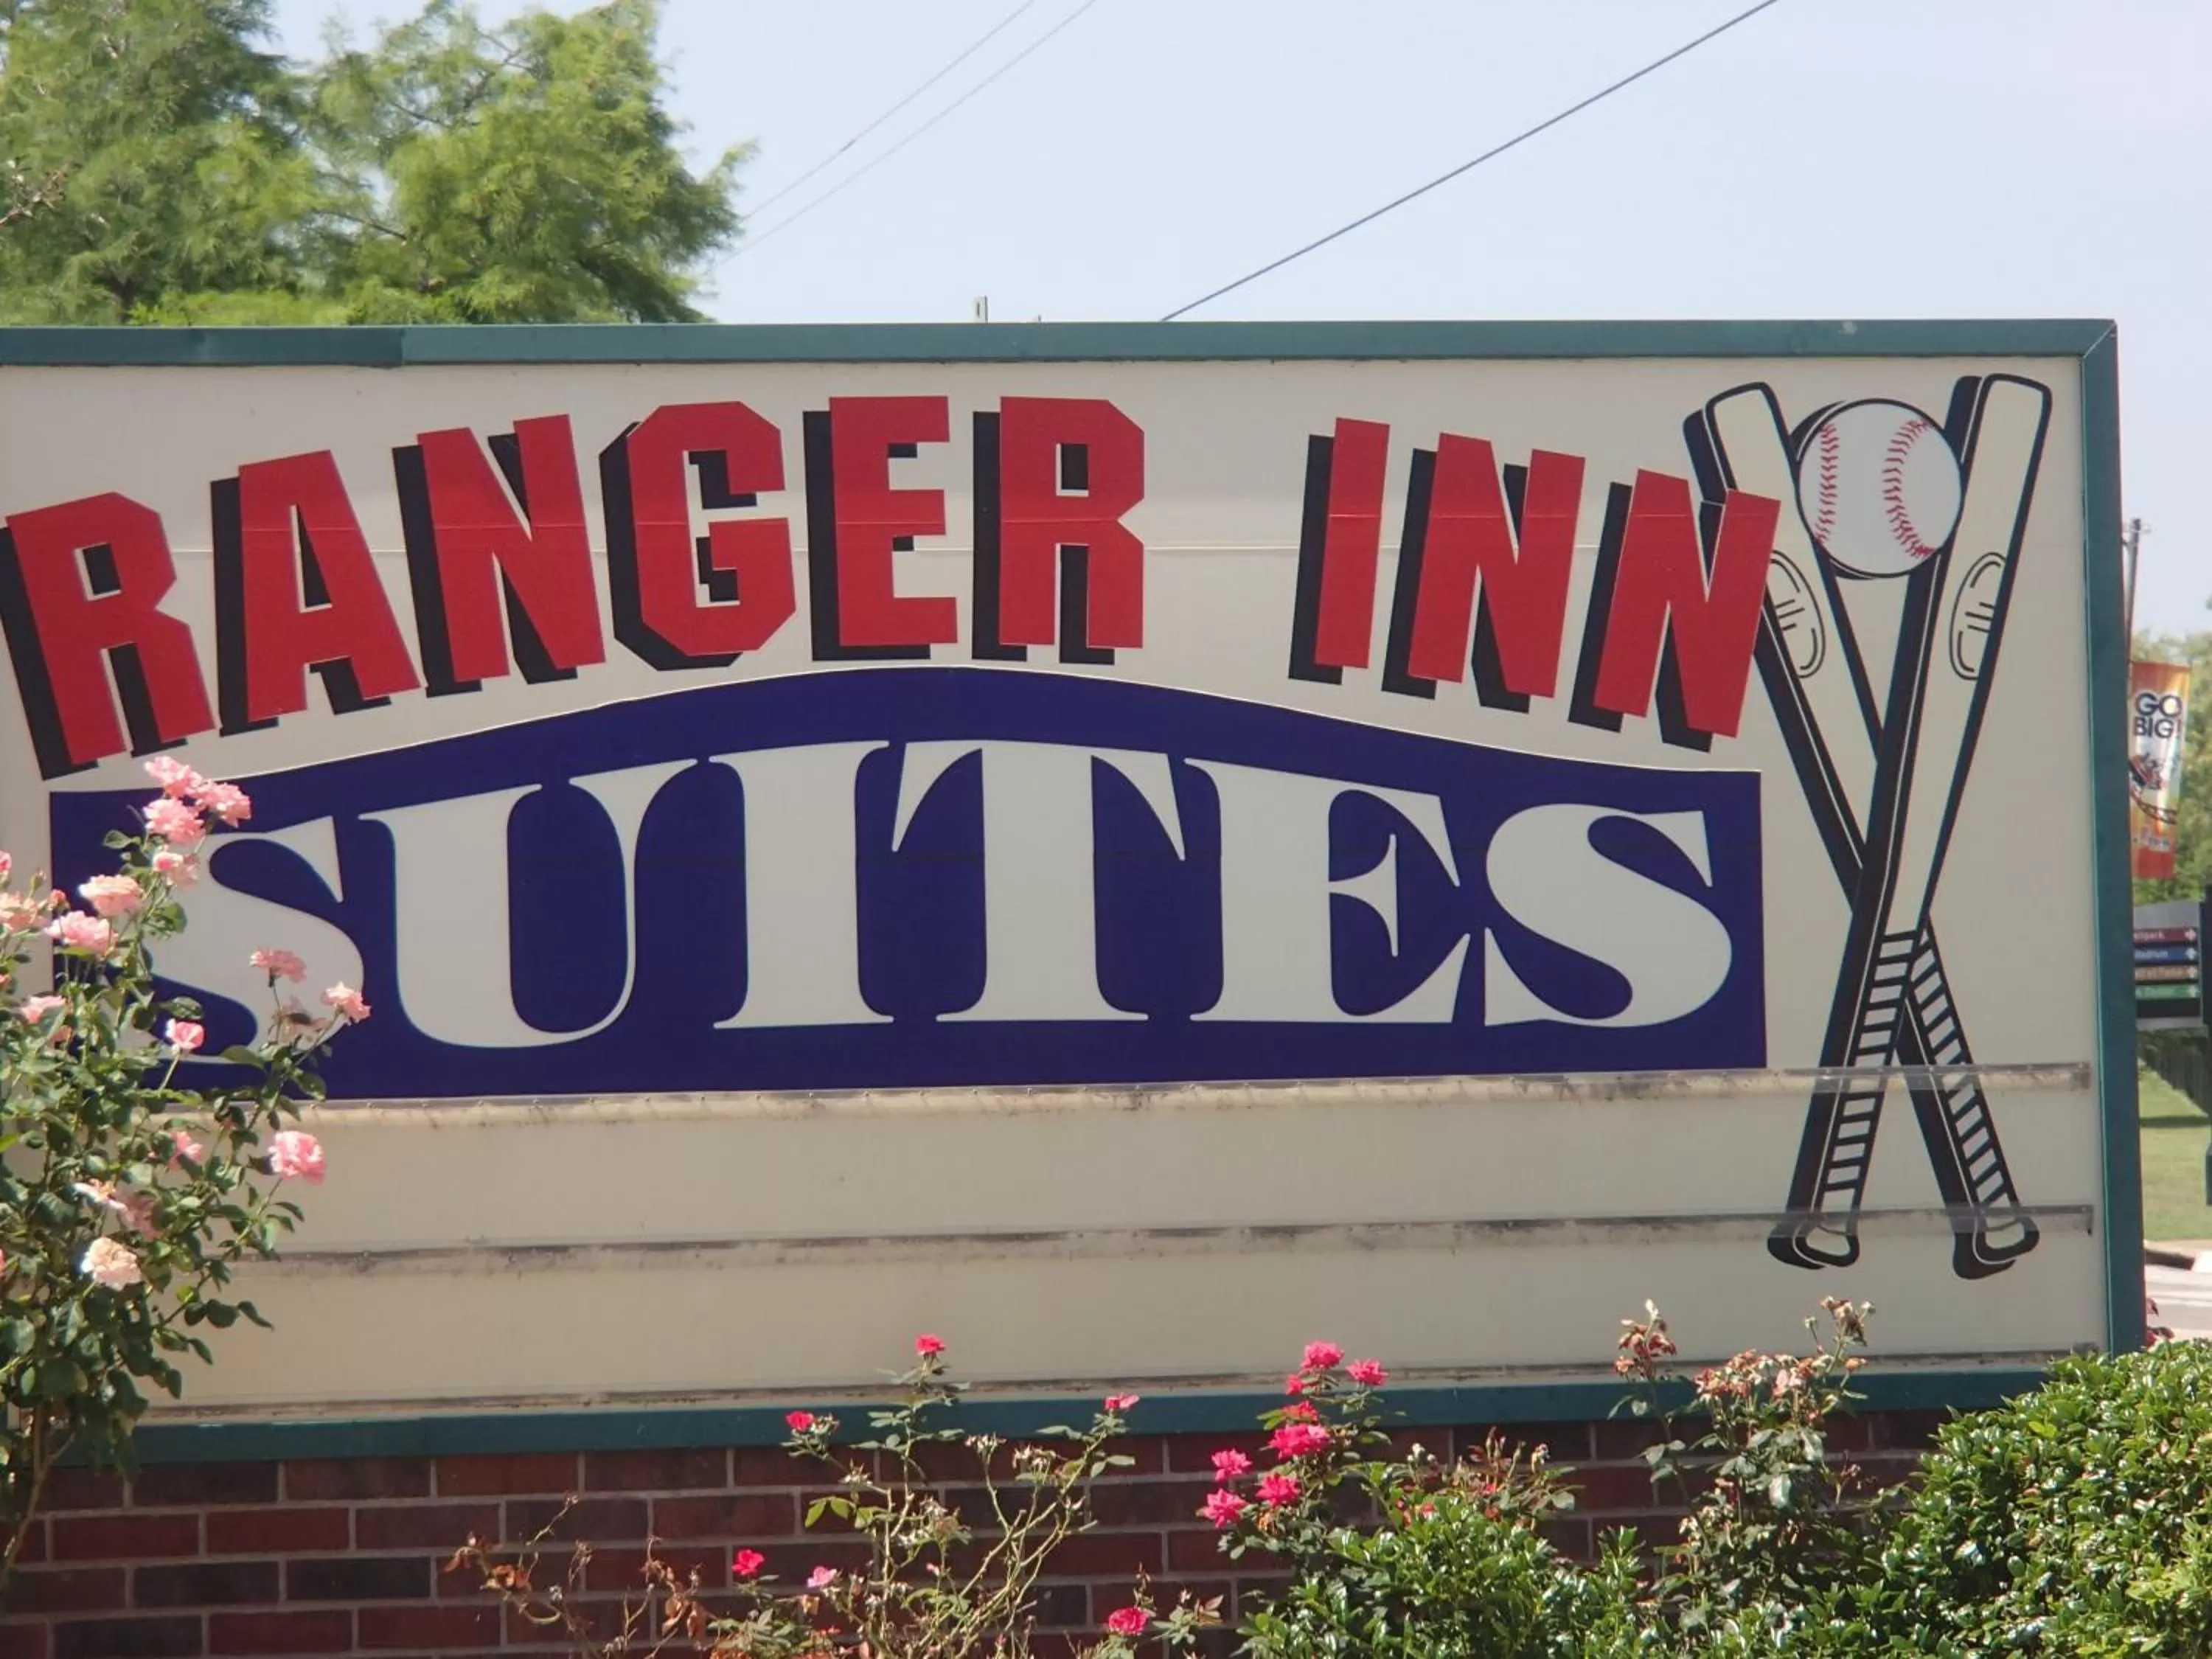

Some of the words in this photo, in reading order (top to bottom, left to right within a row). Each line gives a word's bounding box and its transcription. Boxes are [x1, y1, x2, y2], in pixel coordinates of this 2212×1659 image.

[1, 396, 1144, 776] RANGER
[1294, 417, 1781, 749] INN
[2135, 692, 2182, 717] GO
[103, 740, 1733, 1064] SUITES
